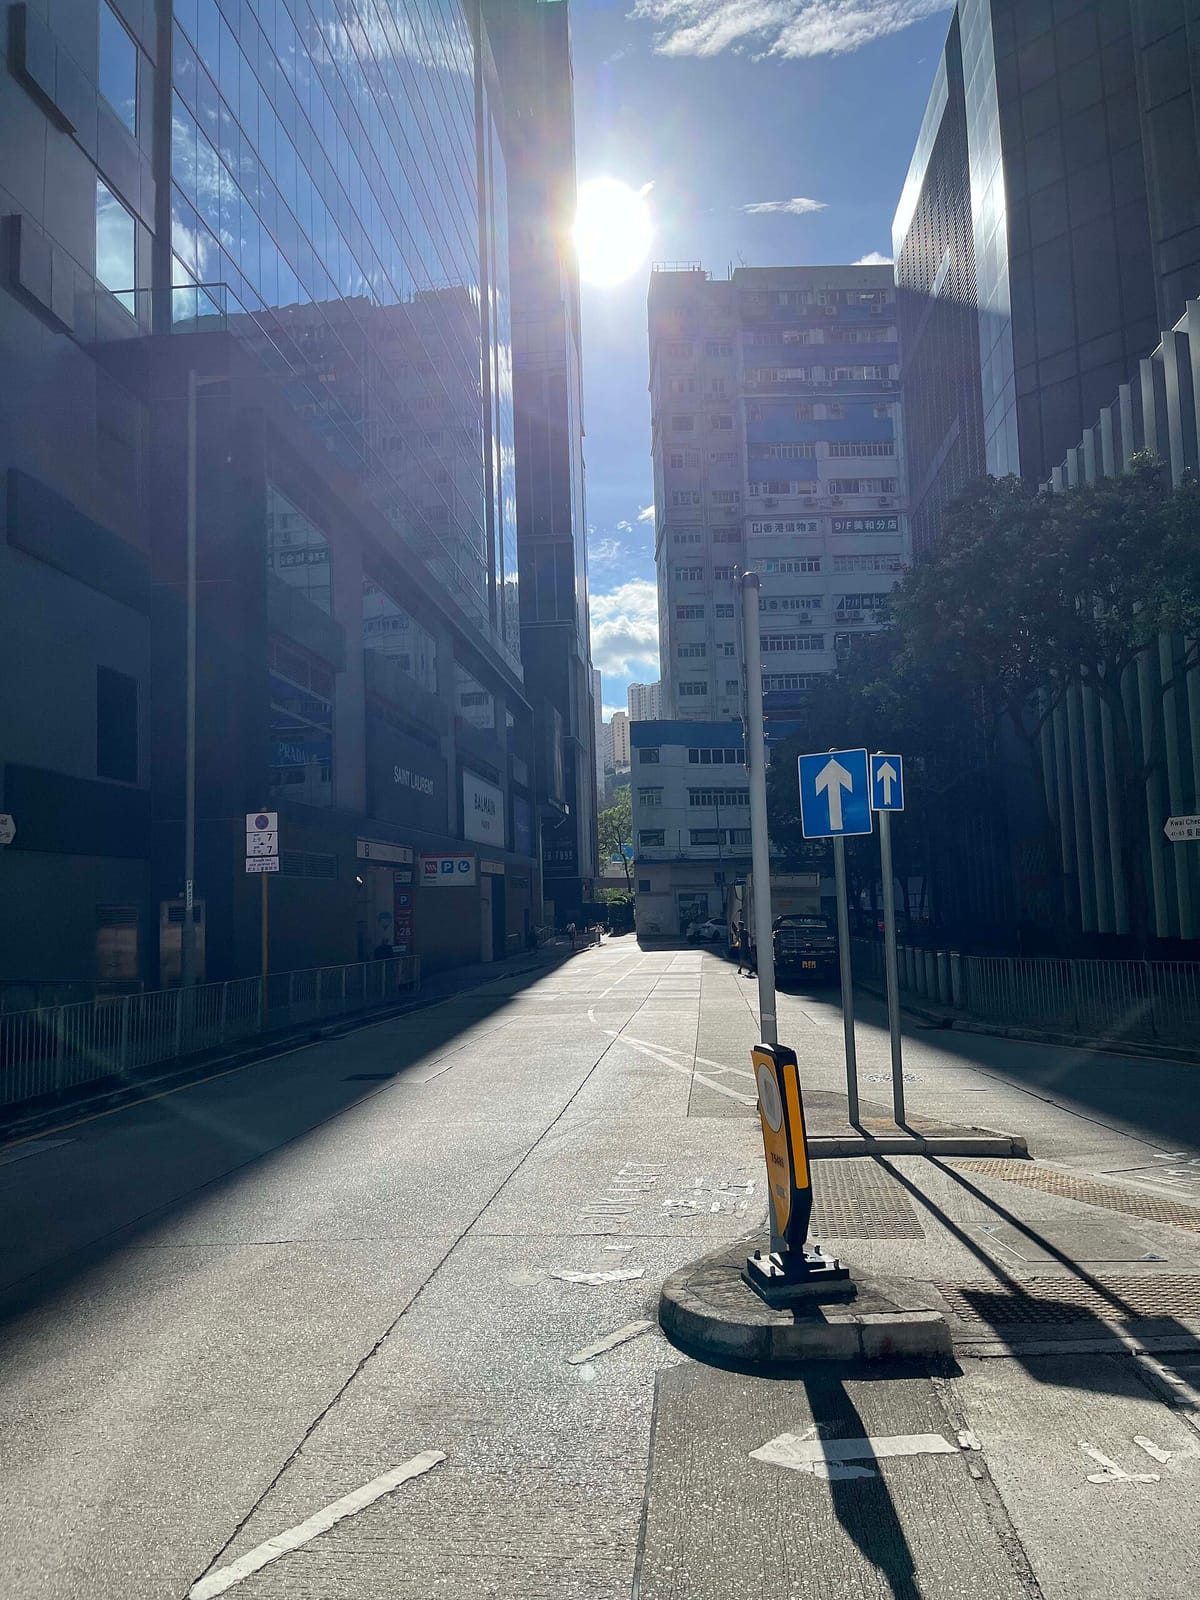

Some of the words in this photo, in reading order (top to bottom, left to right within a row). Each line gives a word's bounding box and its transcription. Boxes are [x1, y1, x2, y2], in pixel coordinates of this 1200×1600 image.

[834, 521, 852, 530] 9/F
[394, 765, 410, 786] SAINT
[410, 772, 434, 795] LAURENT
[266, 846, 272, 854] 7
